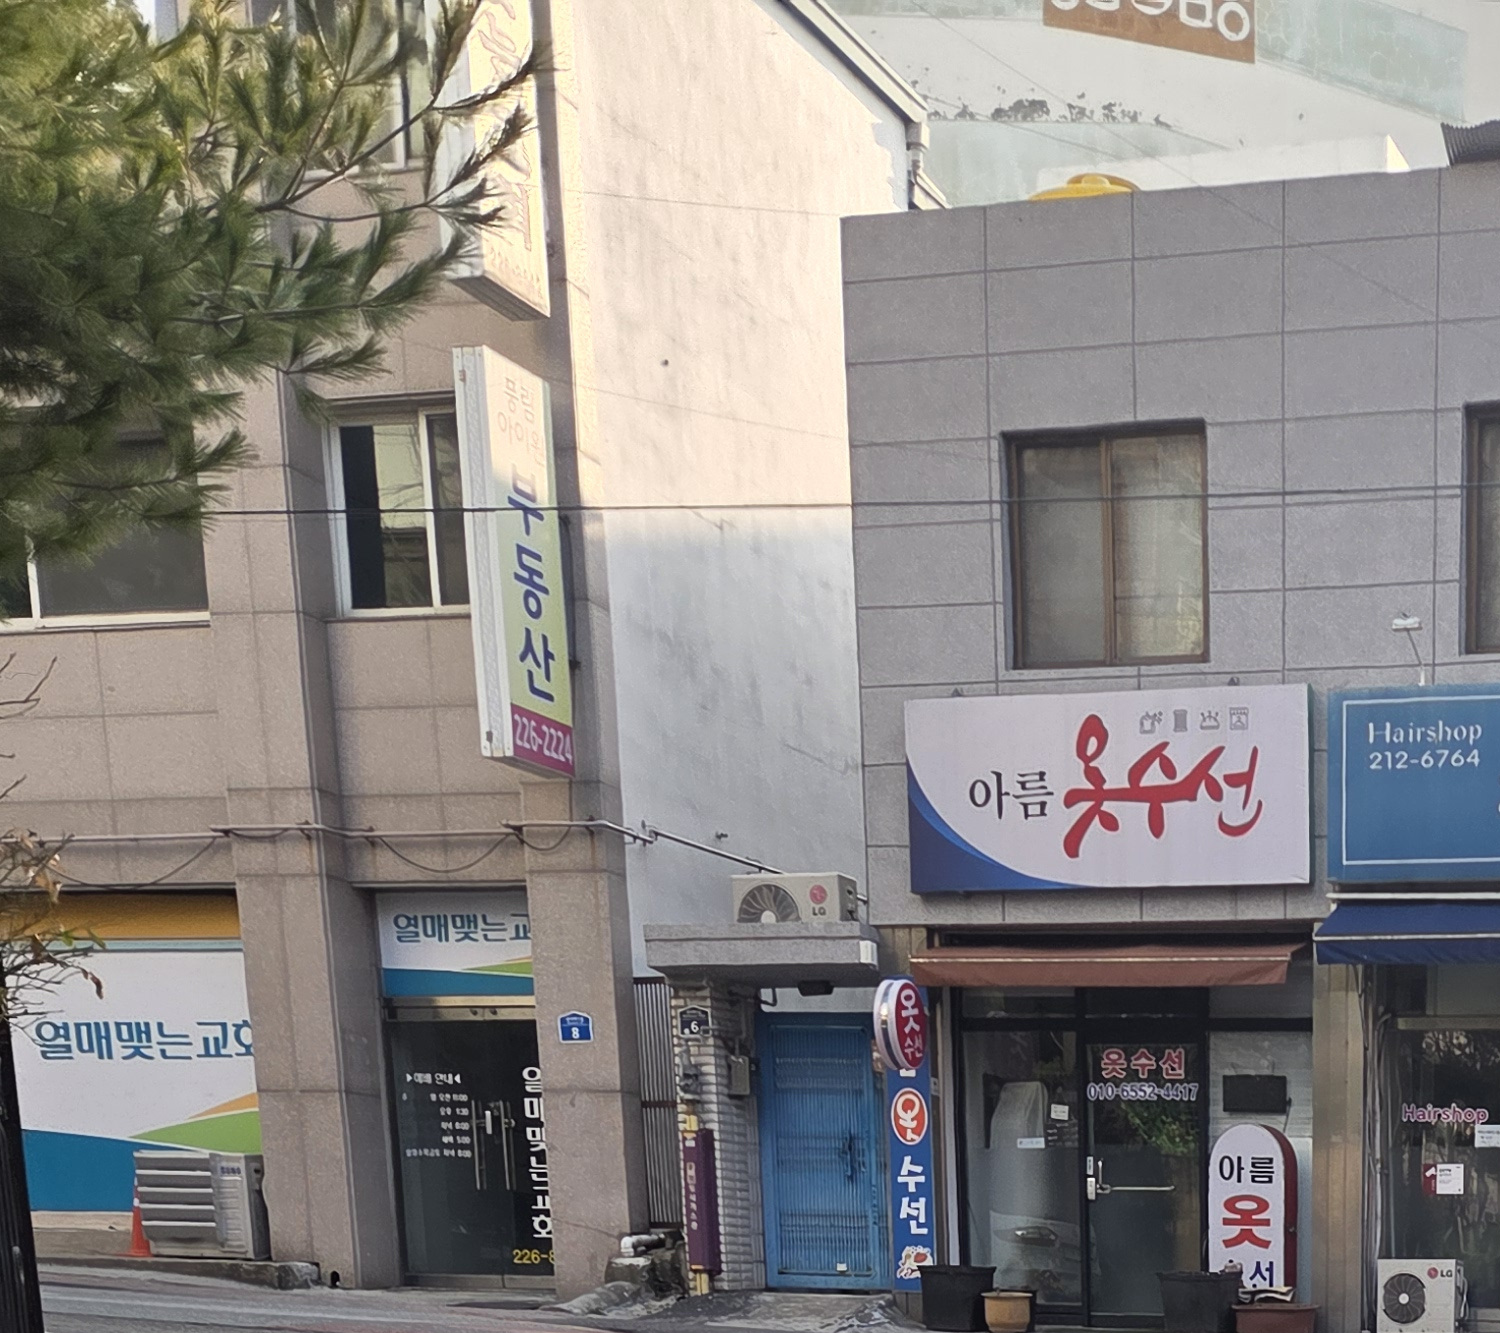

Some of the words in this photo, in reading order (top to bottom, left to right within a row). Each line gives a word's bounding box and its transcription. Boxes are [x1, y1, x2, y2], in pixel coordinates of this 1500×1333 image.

[514, 713, 573, 764] 226-2224
[1368, 719, 1482, 747] Hairshop
[1369, 749, 1480, 770] 212-6764
[969, 770, 1054, 820] 아름
[1063, 714, 1262, 858] 옷수선
[812, 907, 826, 916] LG
[571, 1027, 580, 1040] 8
[690, 1021, 699, 1033] 6
[1101, 1048, 1185, 1079] 옷수선
[1087, 1082, 1199, 1101] 010-6552-4417
[1402, 1103, 1489, 1125] Hairshop
[1219, 1155, 1275, 1184] 아름
[897, 1155, 928, 1234] 수선
[1222, 1194, 1272, 1249] 옷
[1440, 1268, 1453, 1278] LG
